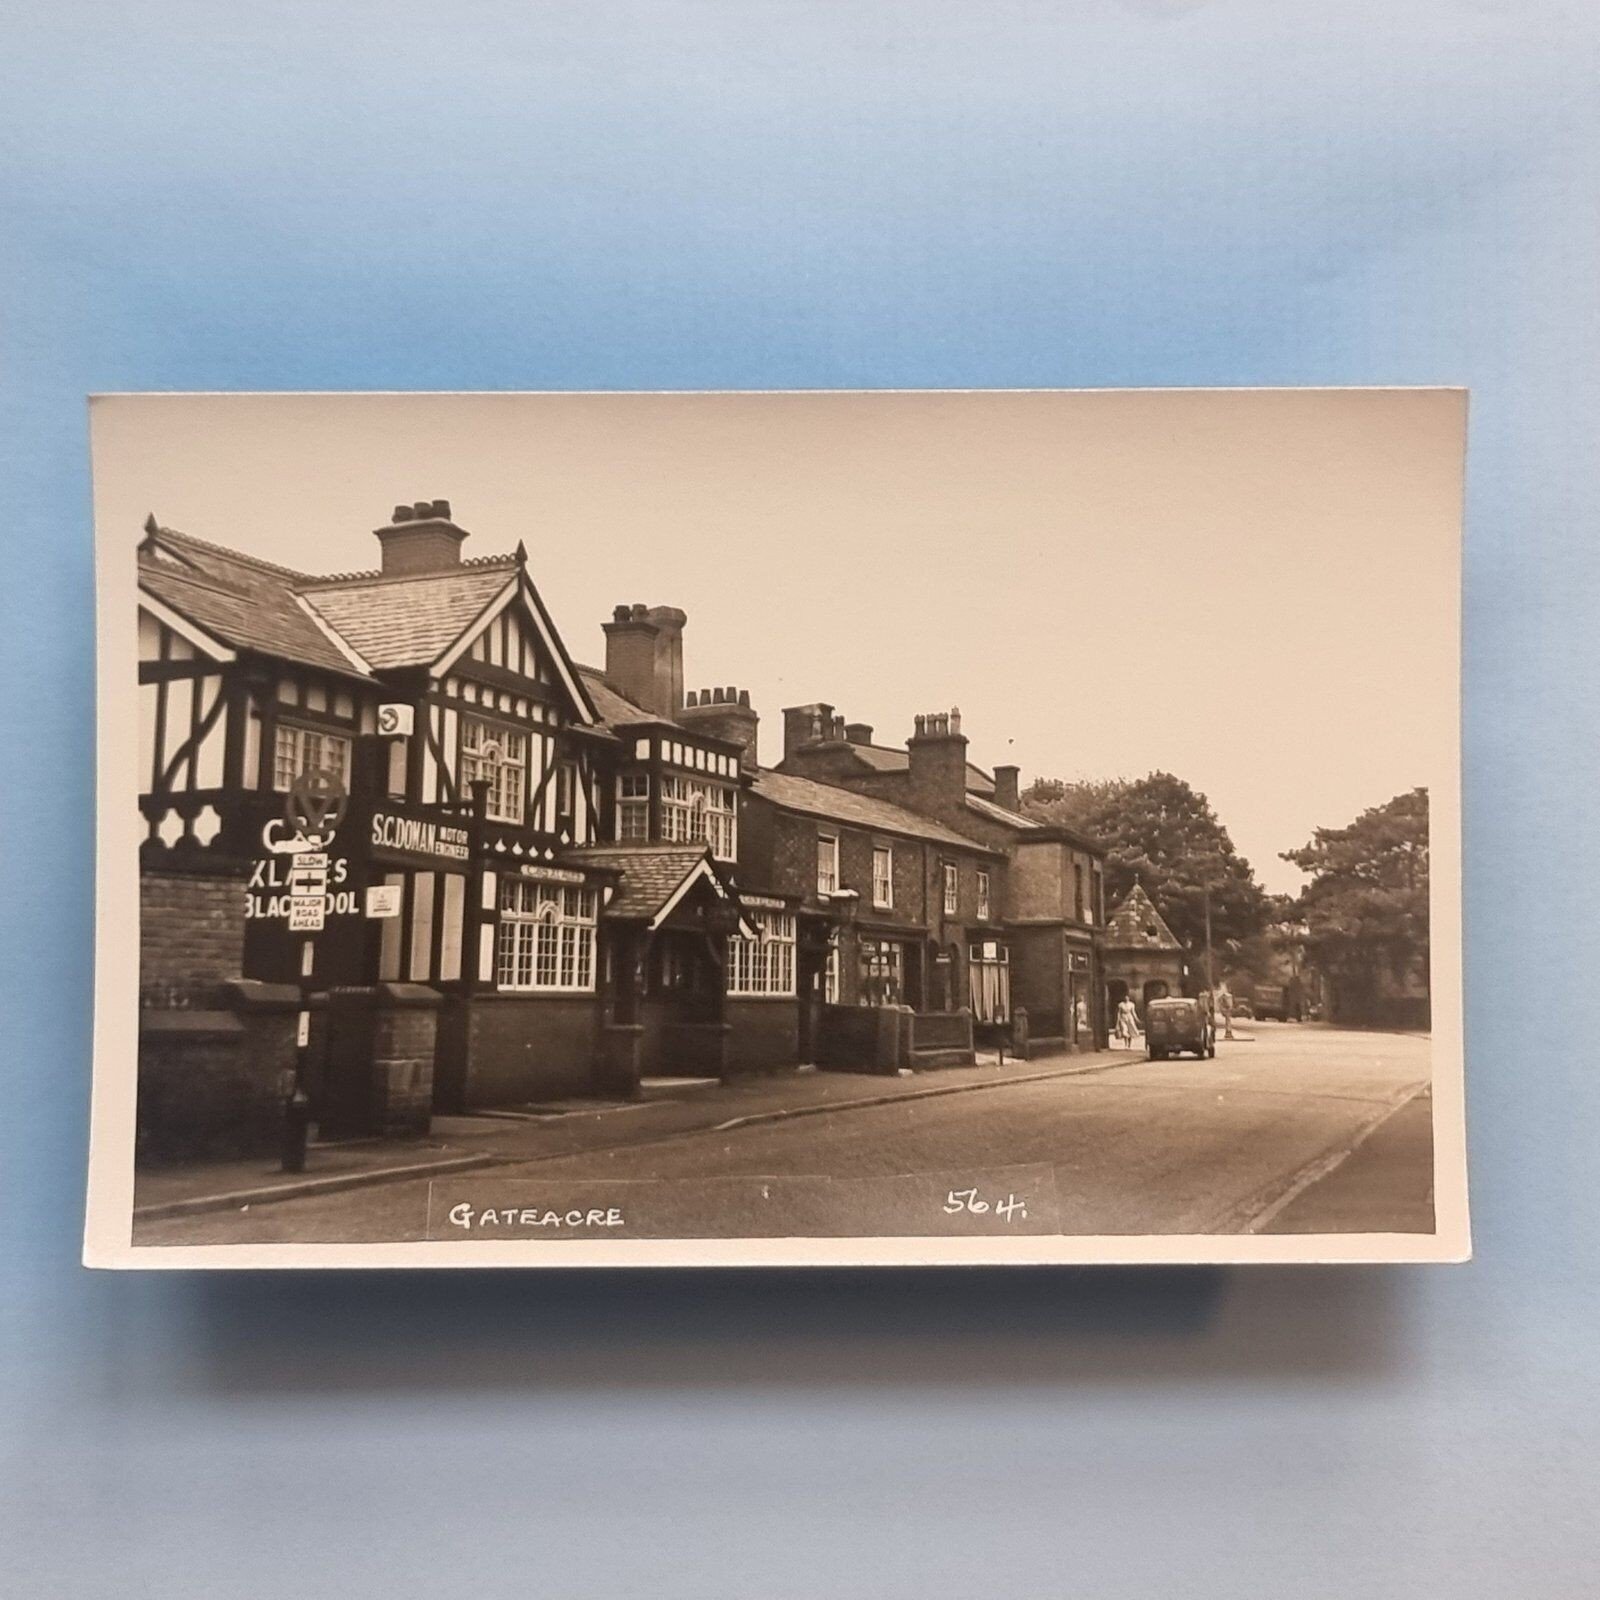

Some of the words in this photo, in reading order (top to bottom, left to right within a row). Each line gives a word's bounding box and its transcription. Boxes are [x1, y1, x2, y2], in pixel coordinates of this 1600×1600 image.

[439, 826, 469, 845] MOTOR
[296, 855, 324, 867] SLOW
[243, 891, 360, 918] BLACOOL
[293, 899, 322, 907] MAJOR
[295, 909, 319, 917] ROAD
[292, 919, 321, 928] AHEAD
[448, 1202, 625, 1230] GATEACRE
